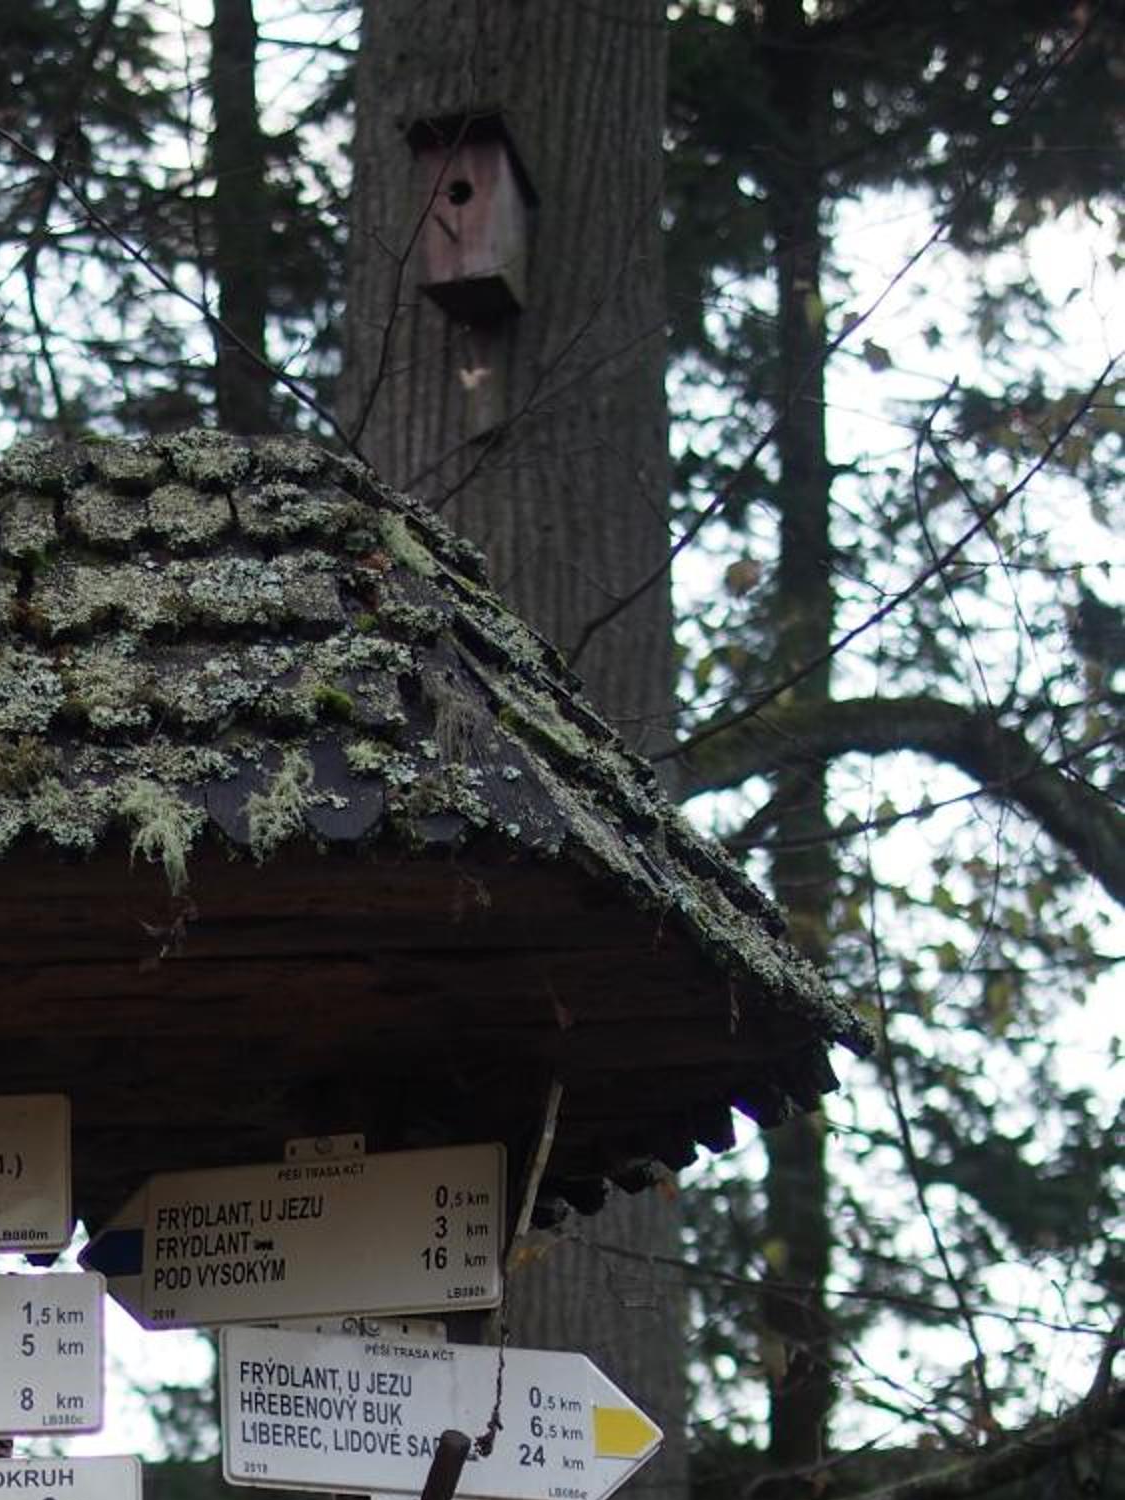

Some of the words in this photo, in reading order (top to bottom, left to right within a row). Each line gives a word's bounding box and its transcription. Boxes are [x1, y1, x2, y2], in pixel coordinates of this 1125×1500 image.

[436, 1184, 463, 1209] 0,5
[467, 1188, 489, 1206] km
[157, 1200, 254, 1234] FRÝDLANT,
[260, 1199, 272, 1222] U
[277, 1195, 323, 1220] JEZU
[435, 1217, 448, 1239] 3
[466, 1222, 488, 1238] km
[156, 1229, 250, 1261] FRÝDLANT
[421, 1247, 447, 1270] 16
[464, 1252, 486, 1268] km
[155, 1264, 191, 1290] POD
[196, 1254, 285, 1287] VYSOKÝM
[22, 1301, 52, 1327] 1,5
[57, 1308, 84, 1326] km
[21, 1334, 35, 1357] 5
[57, 1339, 84, 1356] km
[365, 1343, 392, 1358] PĚŠÍ
[393, 1346, 430, 1360] TRASA
[432, 1347, 455, 1361] KČT
[240, 1357, 343, 1394] FRÝDLANT,
[348, 1374, 360, 1393] U
[366, 1373, 412, 1397] JEZU
[20, 1388, 35, 1411] 8
[56, 1392, 84, 1410] km
[240, 1387, 357, 1419] HŘEBENOVÝ
[363, 1403, 402, 1426] BUK
[530, 1387, 554, 1411] 0,5
[560, 1395, 581, 1412] km
[241, 1423, 328, 1454] LIBEREC,
[333, 1425, 402, 1456] LIDOVÉ
[530, 1415, 557, 1440] 6,5
[560, 1424, 583, 1441] km
[519, 1445, 546, 1468] 24
[562, 1453, 585, 1470] km
